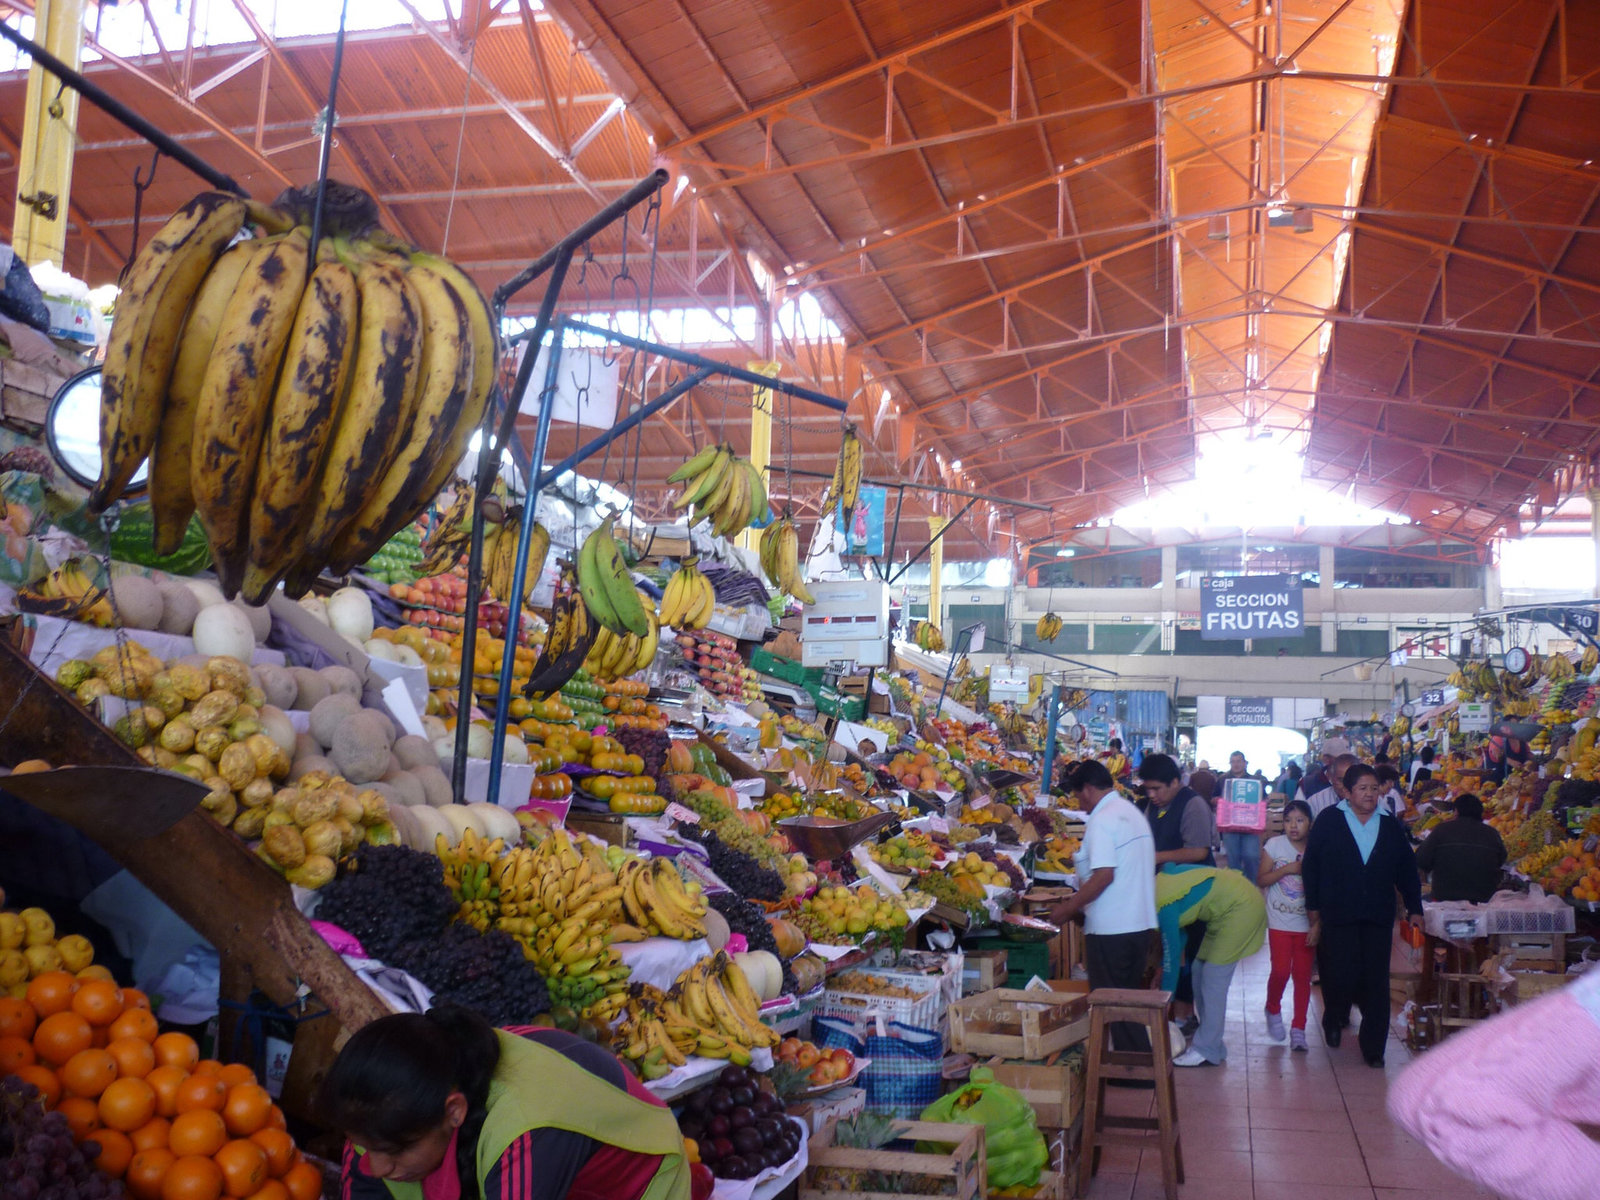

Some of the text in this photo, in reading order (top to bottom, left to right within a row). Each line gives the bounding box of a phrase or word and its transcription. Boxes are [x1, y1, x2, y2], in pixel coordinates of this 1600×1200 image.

[1211, 579, 1234, 589] caja
[1215, 593, 1289, 608] SECCION
[1206, 610, 1300, 631] FRUTAS
[1573, 614, 1592, 628] 30
[1426, 694, 1440, 704] 32
[1227, 714, 1271, 724] PORTALITOS
